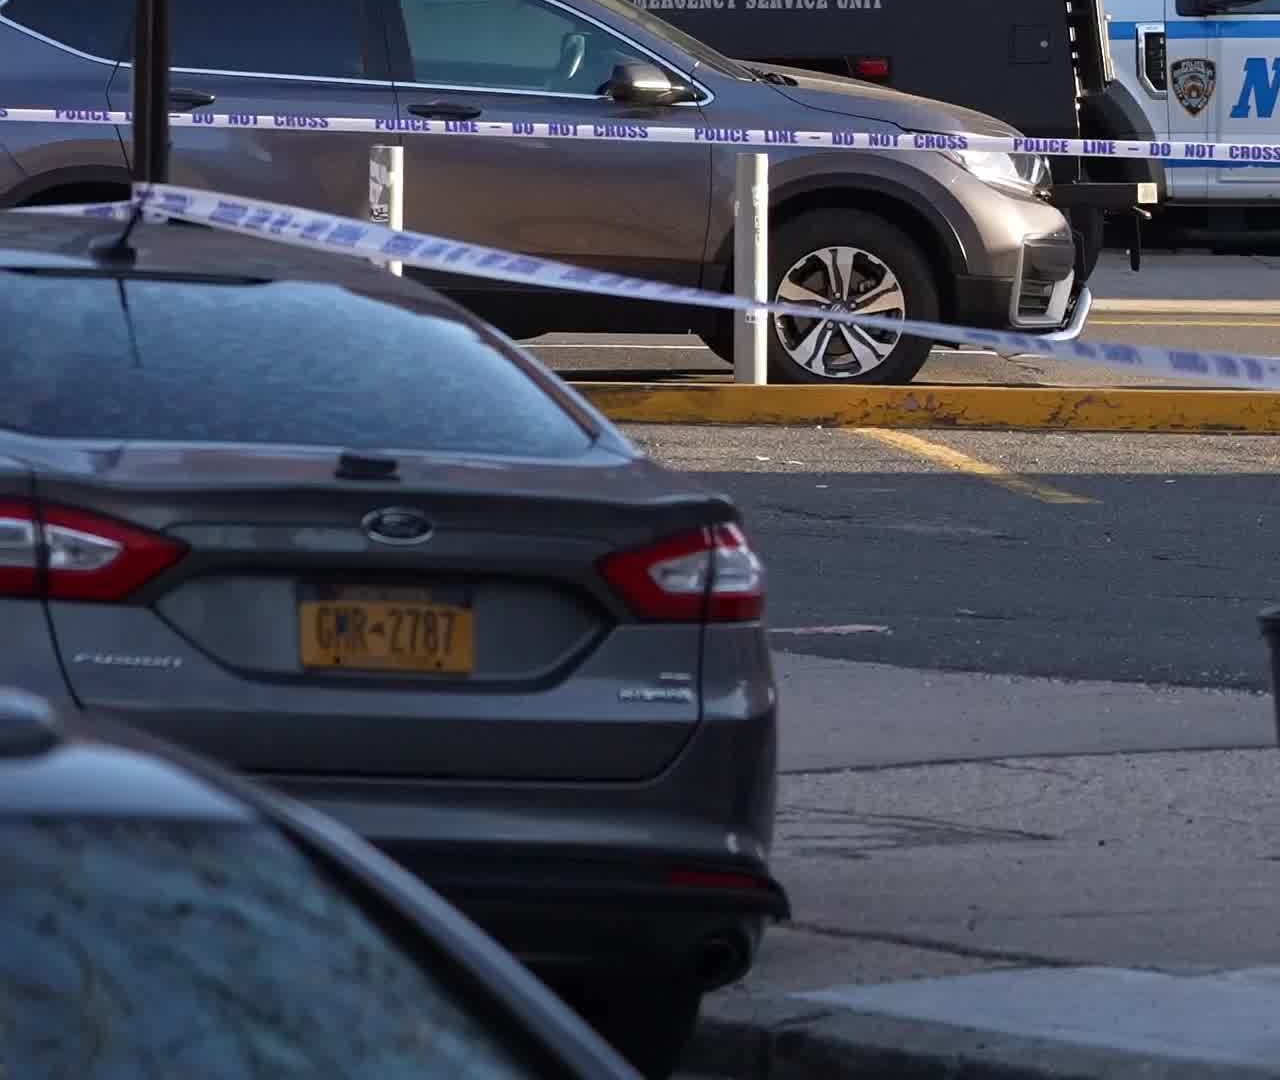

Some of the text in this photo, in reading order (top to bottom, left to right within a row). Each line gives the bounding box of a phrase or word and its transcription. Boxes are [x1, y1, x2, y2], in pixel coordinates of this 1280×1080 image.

[694, 128, 750, 142] POLICE
[764, 130, 800, 144] LINE
[832, 132, 854, 146] DO
[868, 133, 902, 147] NOT
[914, 135, 969, 150] CROSS
[1013, 137, 1069, 154] POLICE
[1083, 139, 1117, 155] LINE
[1150, 142, 1172, 157] DO
[1184, 143, 1217, 159] NOT
